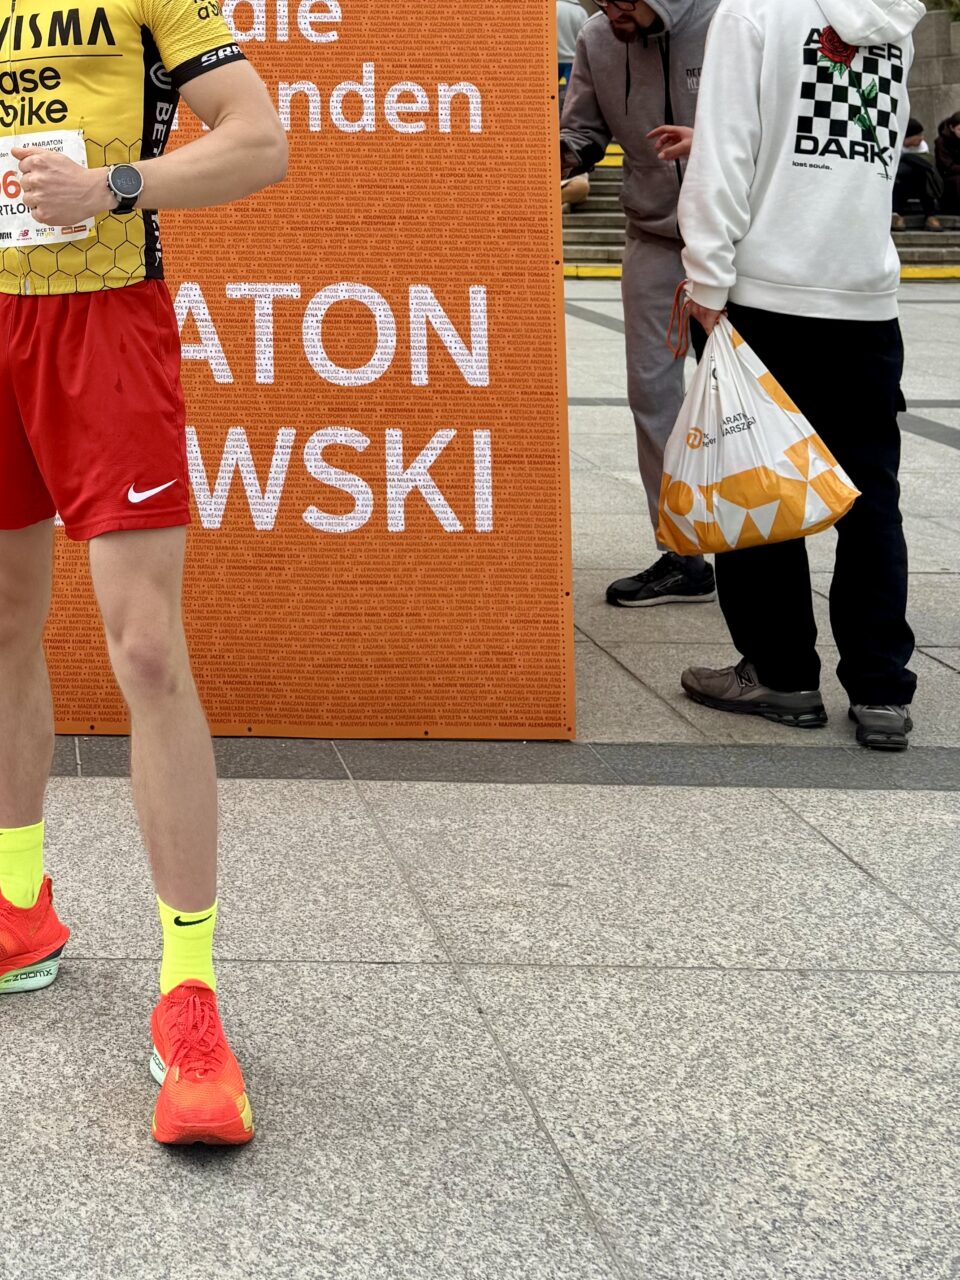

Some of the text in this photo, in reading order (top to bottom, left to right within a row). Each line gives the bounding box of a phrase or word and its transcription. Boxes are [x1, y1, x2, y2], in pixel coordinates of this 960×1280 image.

[201, 45, 243, 66] SRA
[803, 28, 903, 65] AER
[794, 134, 890, 167] DARK
[792, 160, 808, 168] lost
[11, 968, 53, 982] ZOOMX
